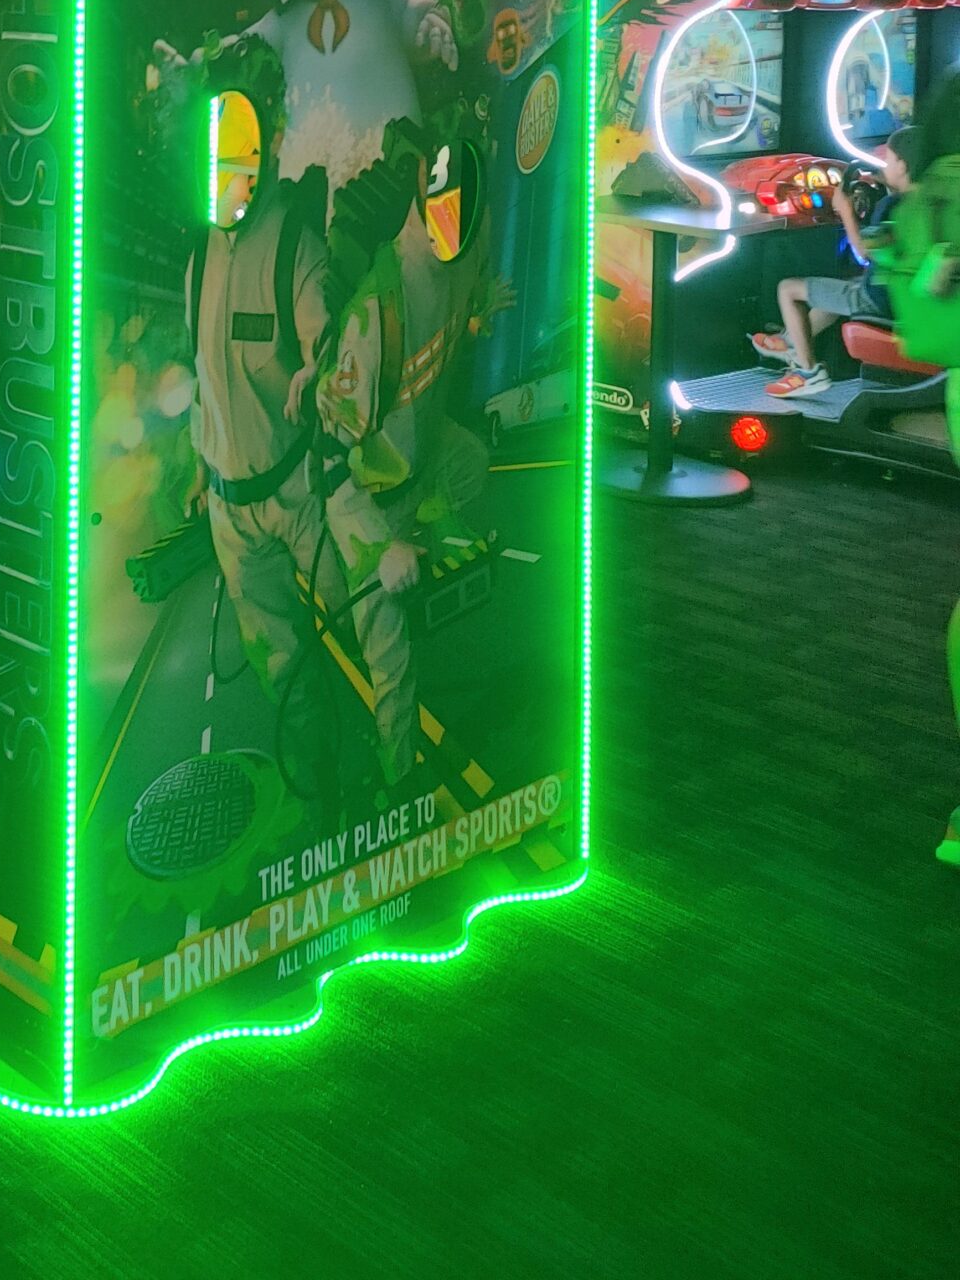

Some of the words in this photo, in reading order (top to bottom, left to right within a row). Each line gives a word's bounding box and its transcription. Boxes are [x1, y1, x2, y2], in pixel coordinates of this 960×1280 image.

[259, 856, 295, 901] THE
[301, 830, 348, 881] ONLY
[354, 804, 410, 858] PLACE
[414, 792, 435, 826] TO
[163, 917, 259, 1003] DRINK,
[269, 875, 333, 951] PLAY
[342, 869, 360, 913] &
[369, 823, 447, 900] WATCH
[277, 947, 302, 981] ALL
[305, 927, 349, 966] UNDER
[351, 908, 377, 941] ONE
[380, 892, 412, 927] ROOF
